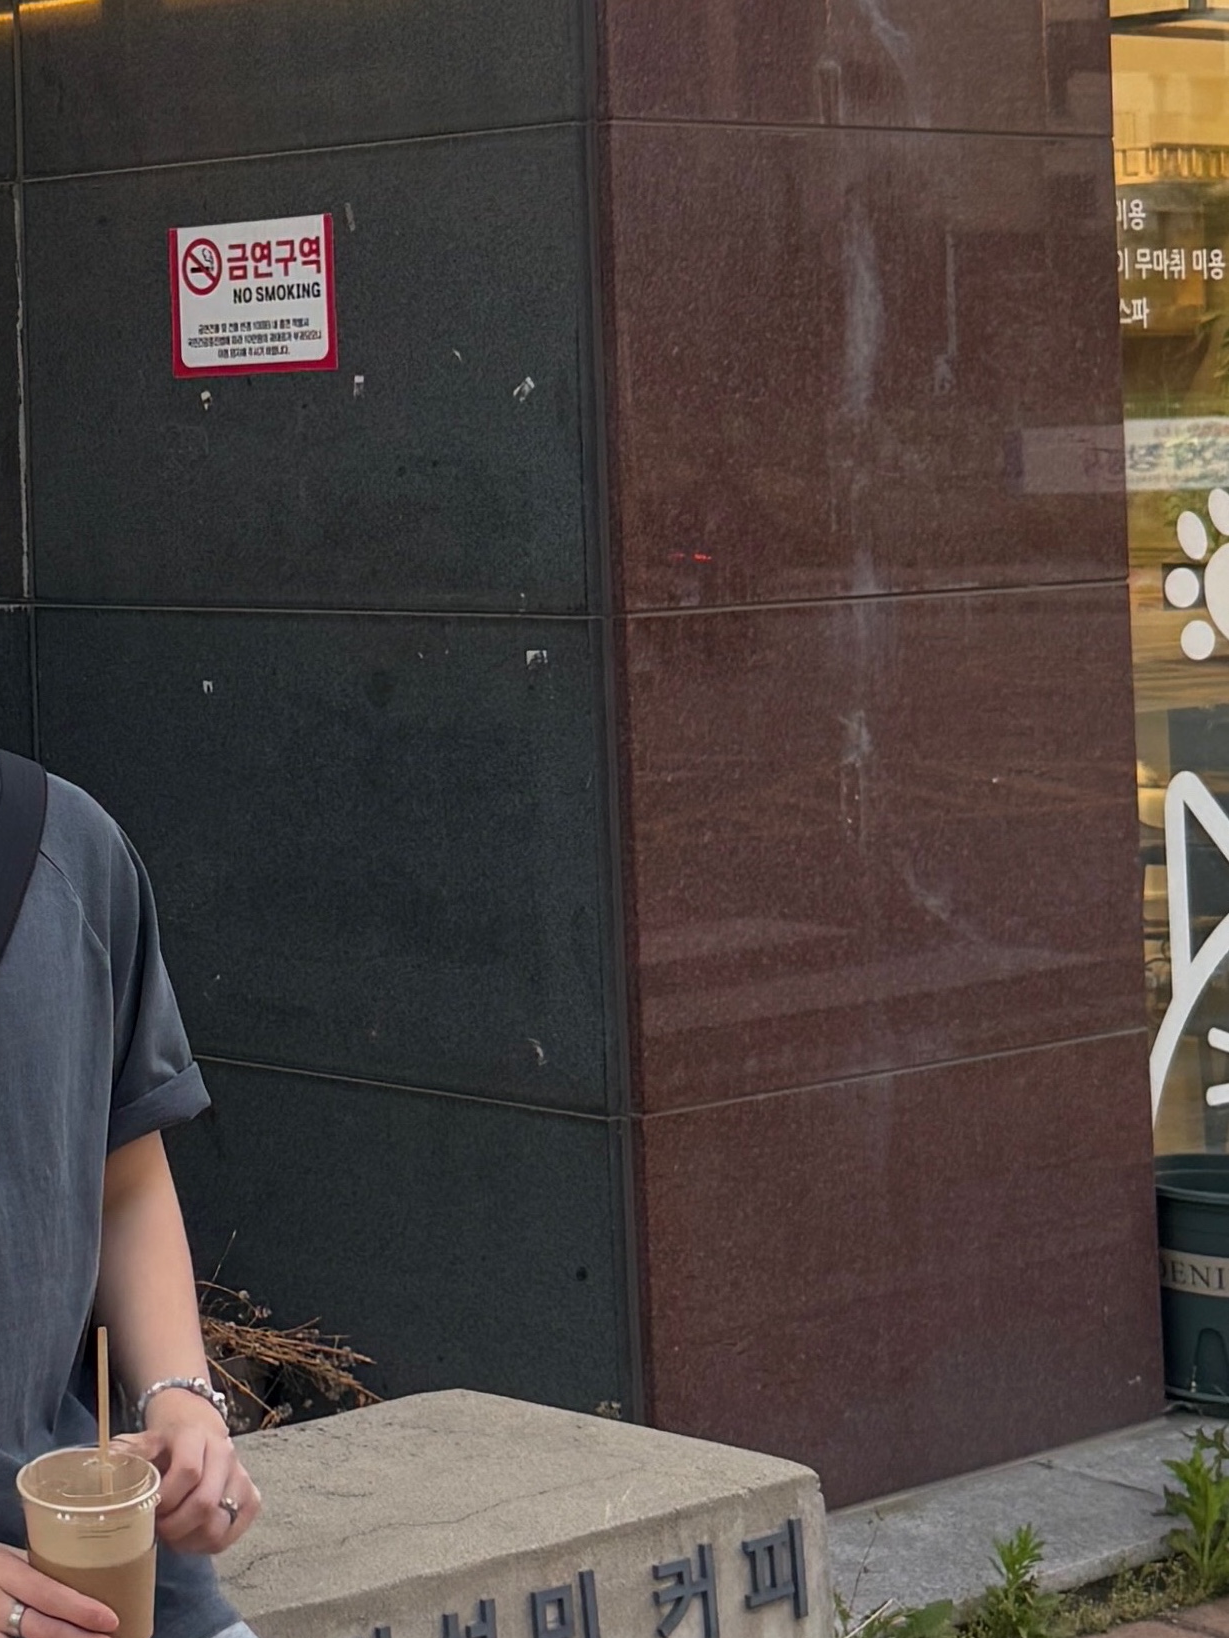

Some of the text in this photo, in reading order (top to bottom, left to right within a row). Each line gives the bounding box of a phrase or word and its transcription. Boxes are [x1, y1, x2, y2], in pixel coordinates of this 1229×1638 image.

[227, 236, 322, 281] 금연구역
[1135, 248, 1186, 280] 무마취
[1192, 248, 1226, 280] 미용
[233, 282, 321, 304] NO SMOKING
